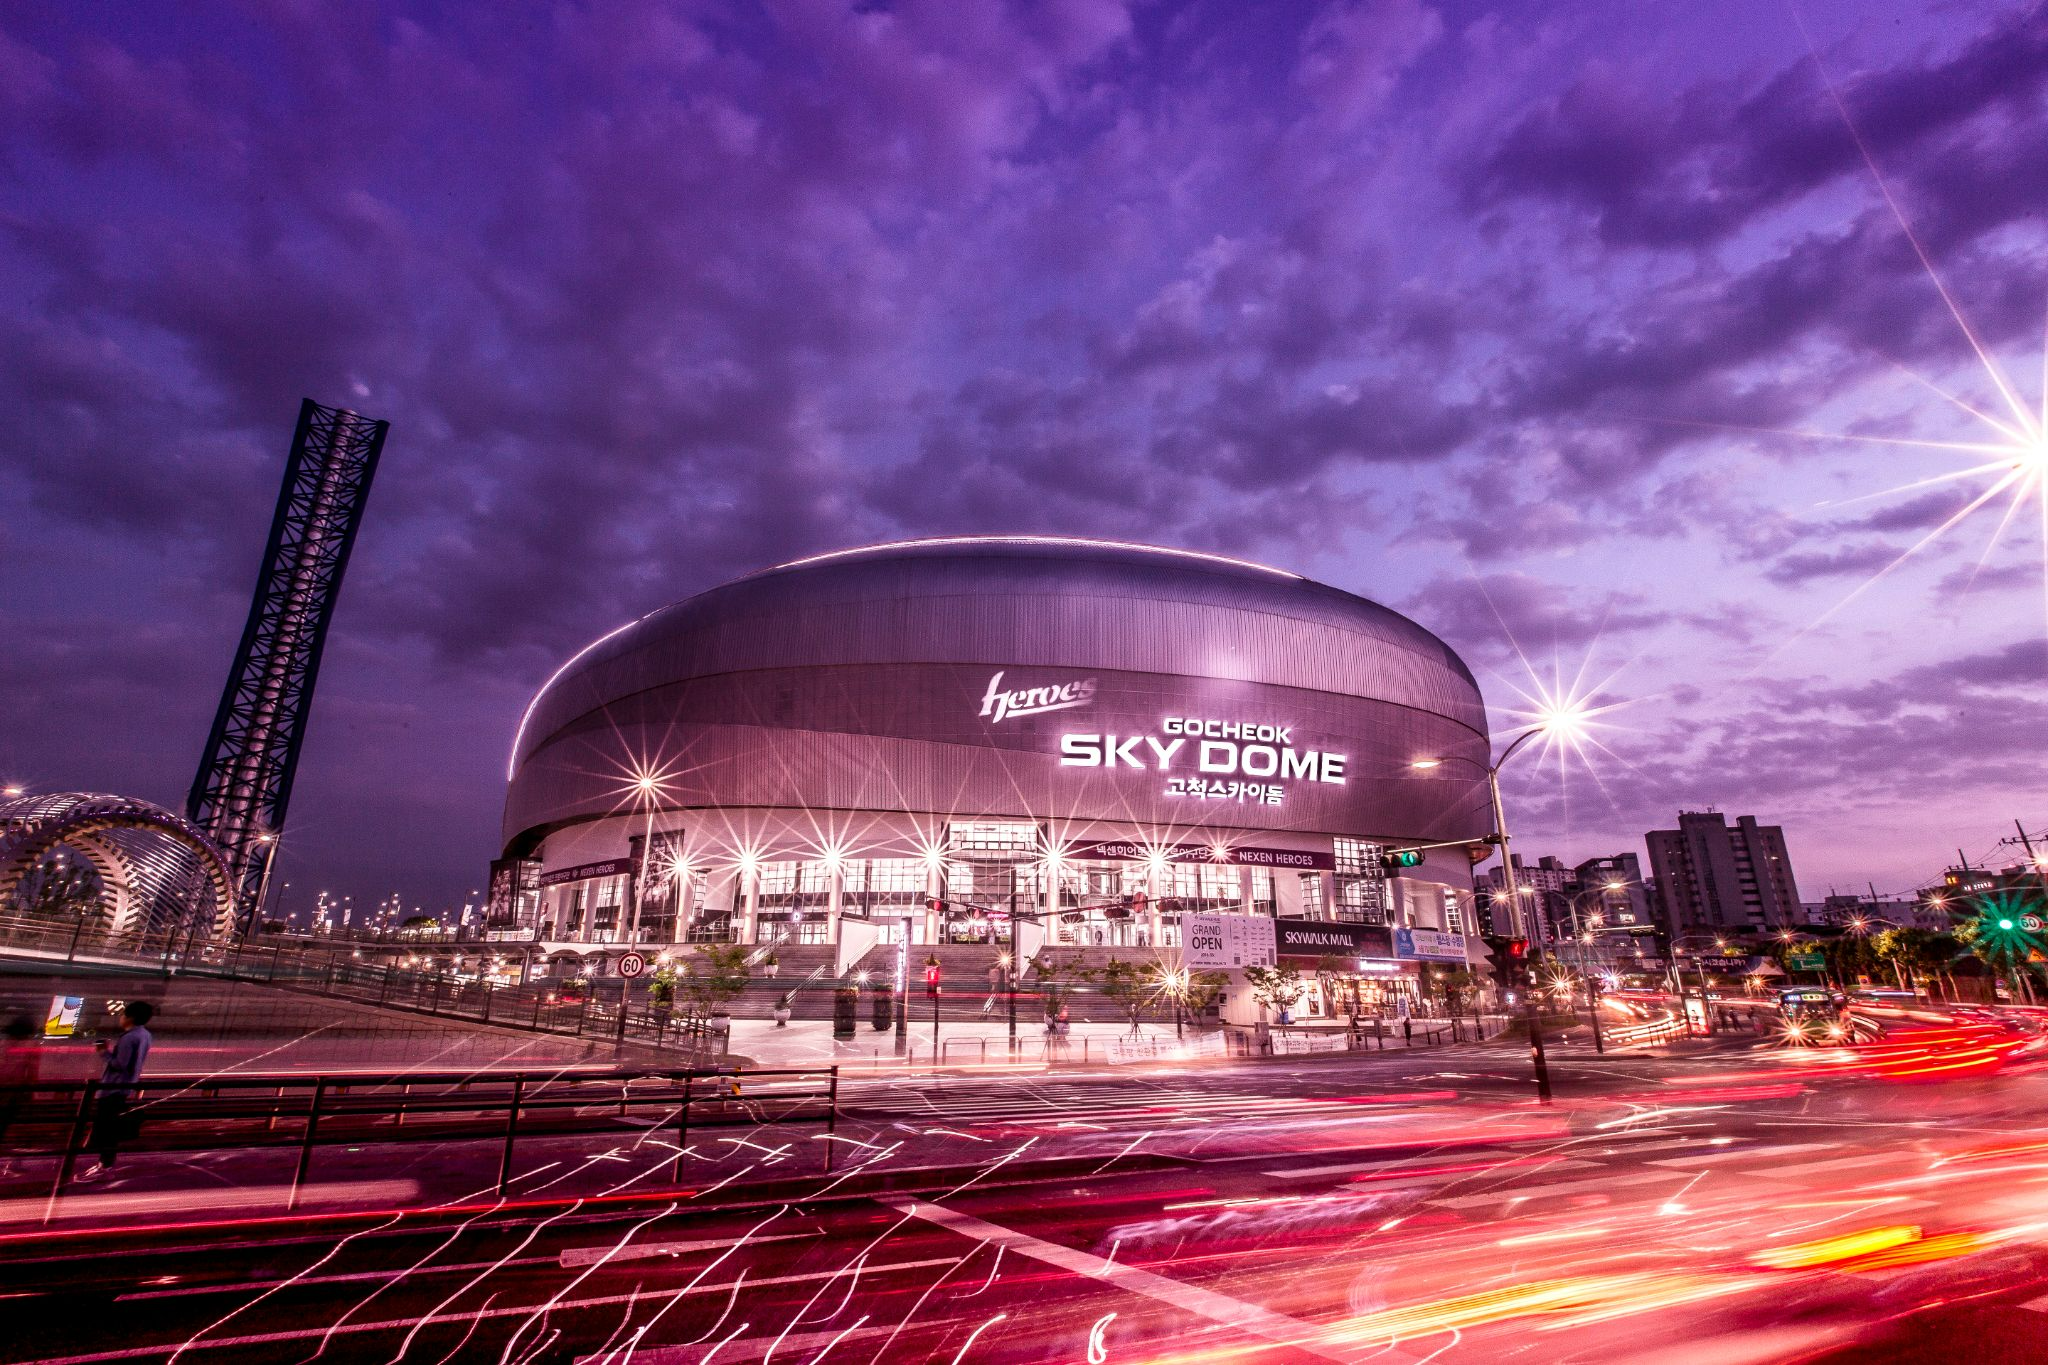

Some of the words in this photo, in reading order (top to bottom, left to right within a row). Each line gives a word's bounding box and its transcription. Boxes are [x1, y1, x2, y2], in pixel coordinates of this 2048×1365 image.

[978, 671, 1097, 723] heroes
[1163, 717, 1292, 744] GOCHEOK
[1060, 733, 1186, 769] SKY
[1199, 741, 1347, 785] DOME
[1165, 778, 1285, 805] 고척스카이돔
[1096, 845, 1155, 858] 넥센히어로
[1164, 847, 1208, 860] 로야구단
[1239, 851, 1273, 864] NEXEN
[1276, 853, 1313, 866] HEROES
[580, 867, 595, 877] NEXEN
[596, 864, 615, 875] HEROES
[1192, 924, 1222, 936] GRAND
[2021, 917, 2037, 928] 60
[1192, 936, 1223, 950] OPEN
[1285, 931, 1329, 945] SKYWALK
[1330, 932, 1354, 947] MALL
[623, 959, 638, 972] 60
